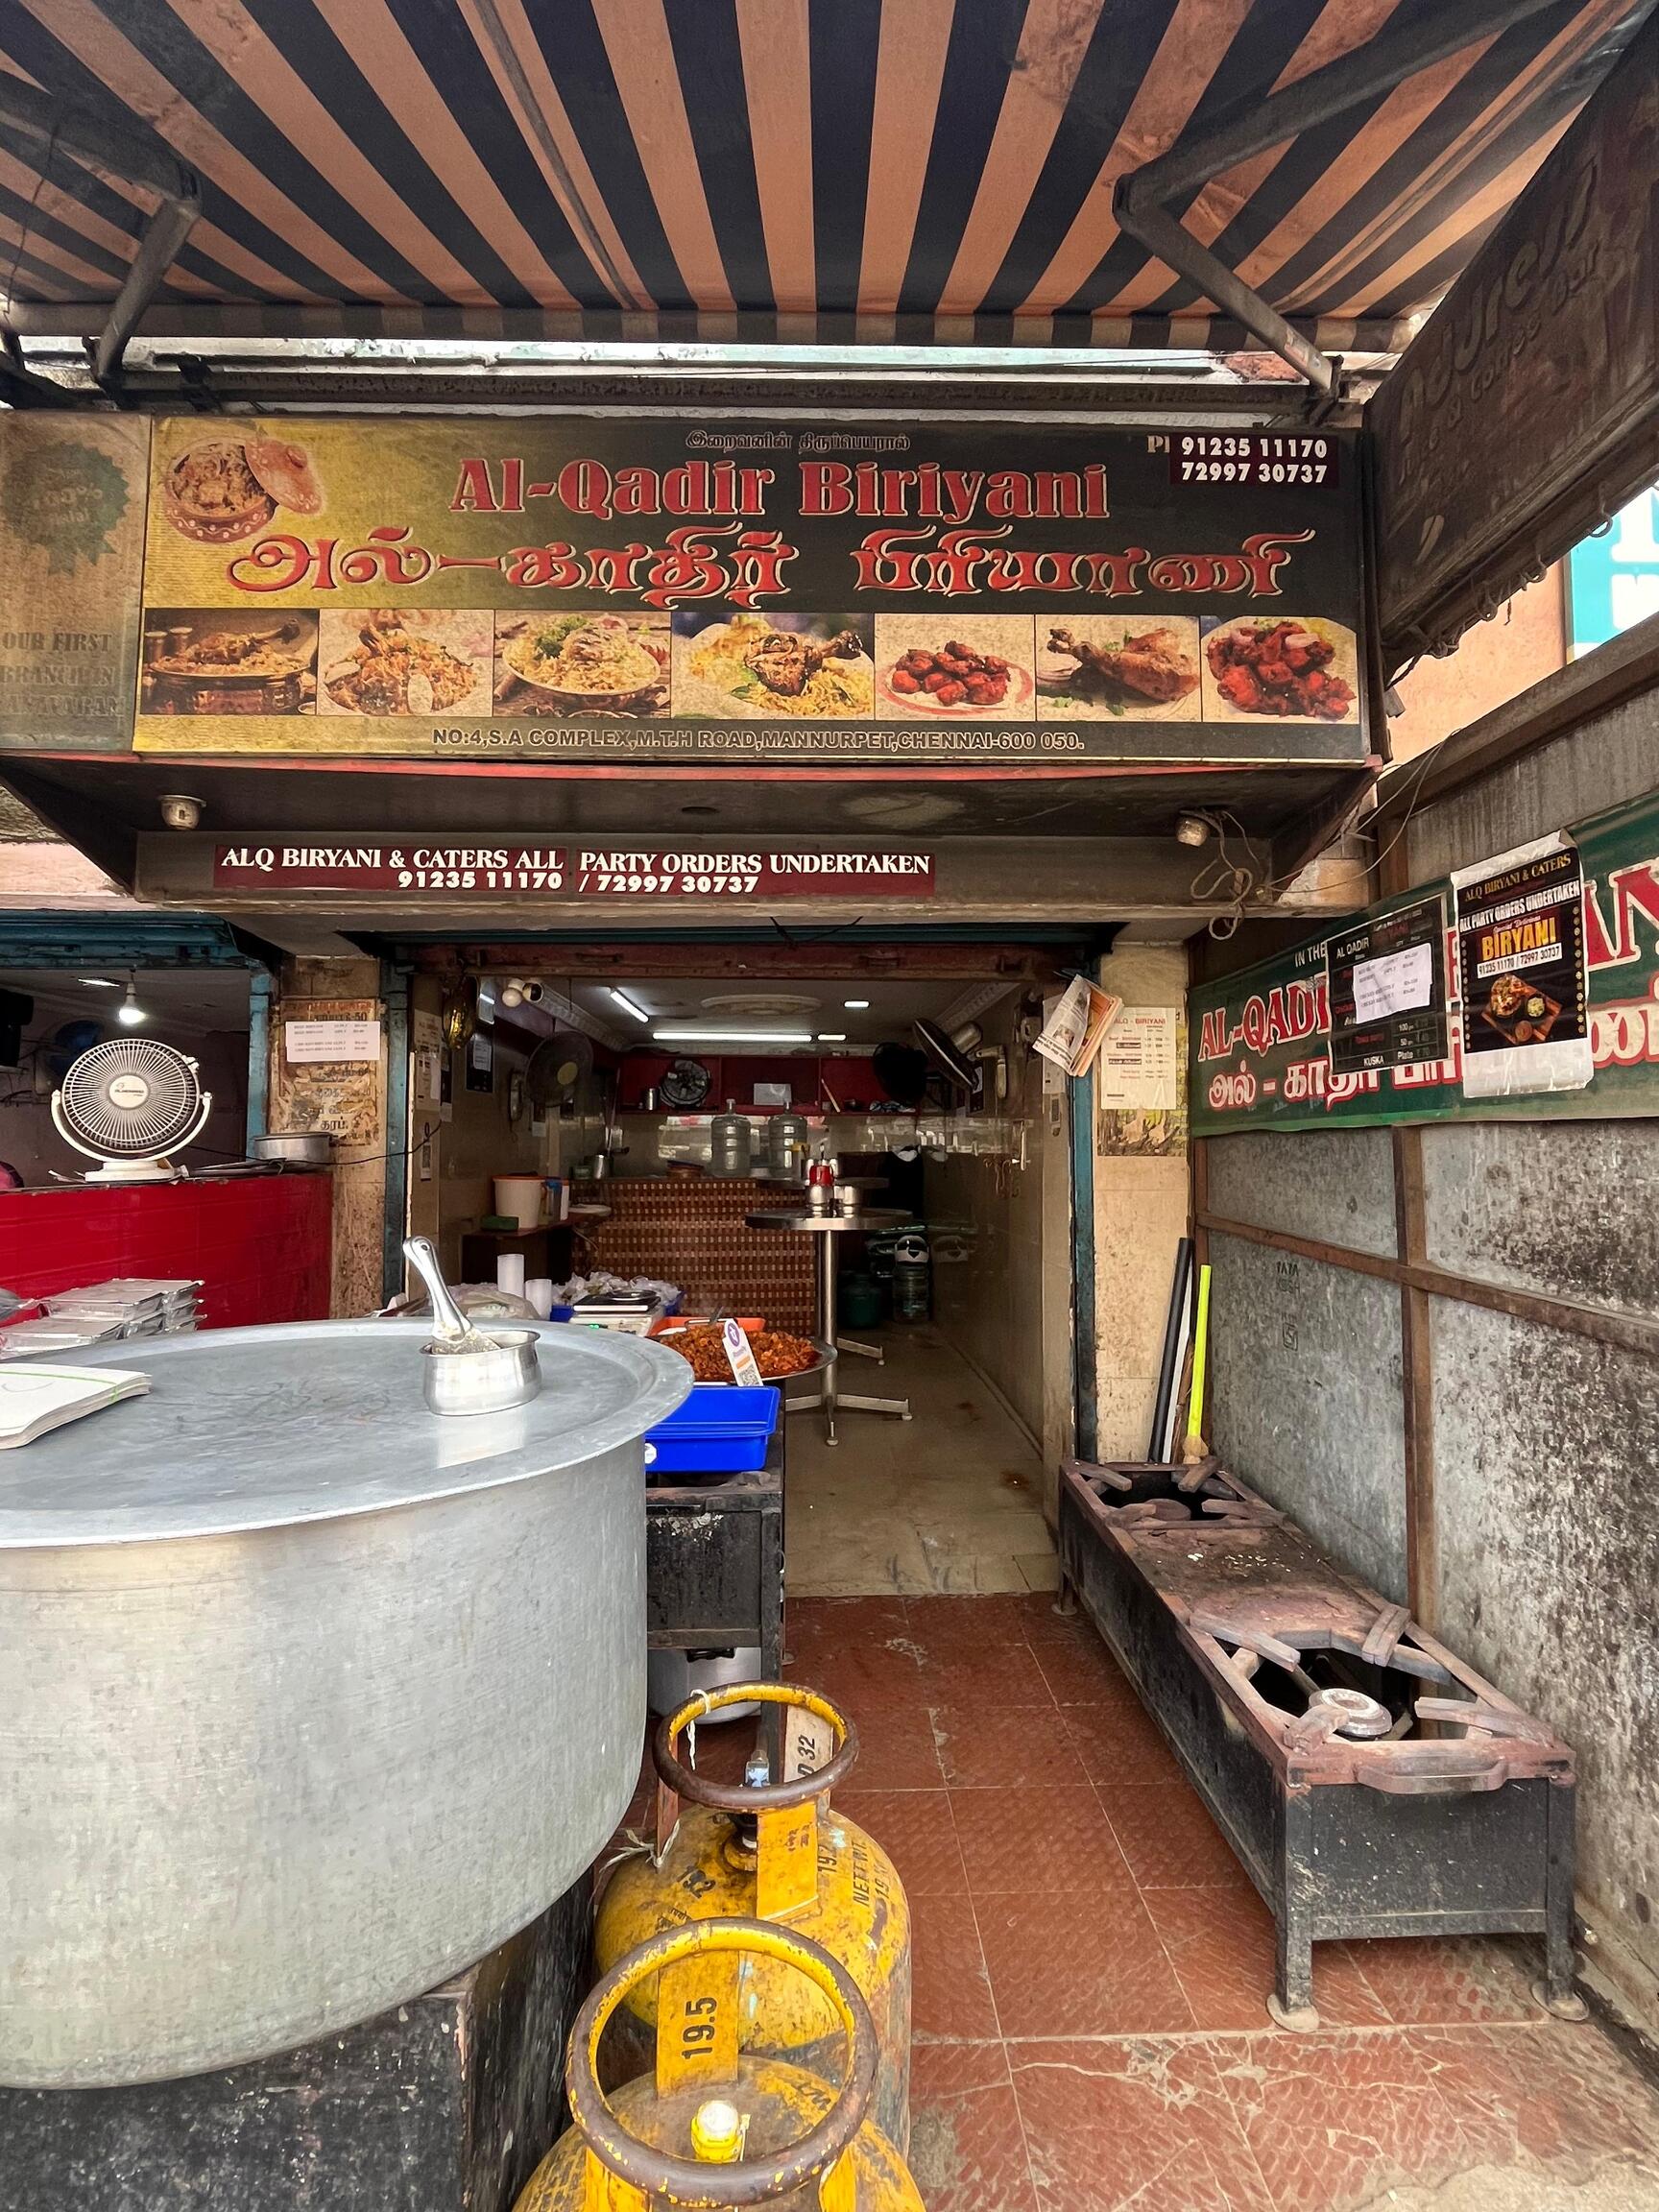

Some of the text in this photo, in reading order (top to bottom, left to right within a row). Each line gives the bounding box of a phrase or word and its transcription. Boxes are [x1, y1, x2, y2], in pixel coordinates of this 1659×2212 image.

[1181, 436, 1251, 456] 91235
[1260, 438, 1328, 459] 11170
[1182, 462, 1328, 483] 72997 30737
[448, 458, 1111, 524] Al-Qadir Biriyani
[850, 524, 1316, 598] பிரியாணி
[2, 632, 112, 652] OUR FIRST
[433, 729, 1085, 752] NO:4,S.A COMPLEX,M.T.H ROAD,MANNURPET,CHENNAI-600 050.
[221, 848, 930, 875] ALQ BIRYANI & CATERS ALL PARTY ORDERS UNDERTAKEN
[398, 871, 758, 894] 91235 11170 / 72997 30737
[1465, 854, 1572, 902] ALQ BIRYANI & CATERS
[1460, 879, 1580, 933] ALL PARTY ORDERS UNDERTAKEN
[1336, 946, 1346, 959] AL
[1481, 917, 1557, 961] BIRYANI
[1295, 951, 1306, 967] IN
[1479, 963, 1496, 975] 91235
[1497, 960, 1514, 973] 11170
[1521, 952, 1538, 965] 72997
[1540, 946, 1560, 959] 30737
[1363, 1056, 1384, 1068] KUSKA
[1210, 1060, 1256, 1109] அல்
[798, 1734, 815, 1761] 32
[682, 1996, 717, 2059] 19.5
